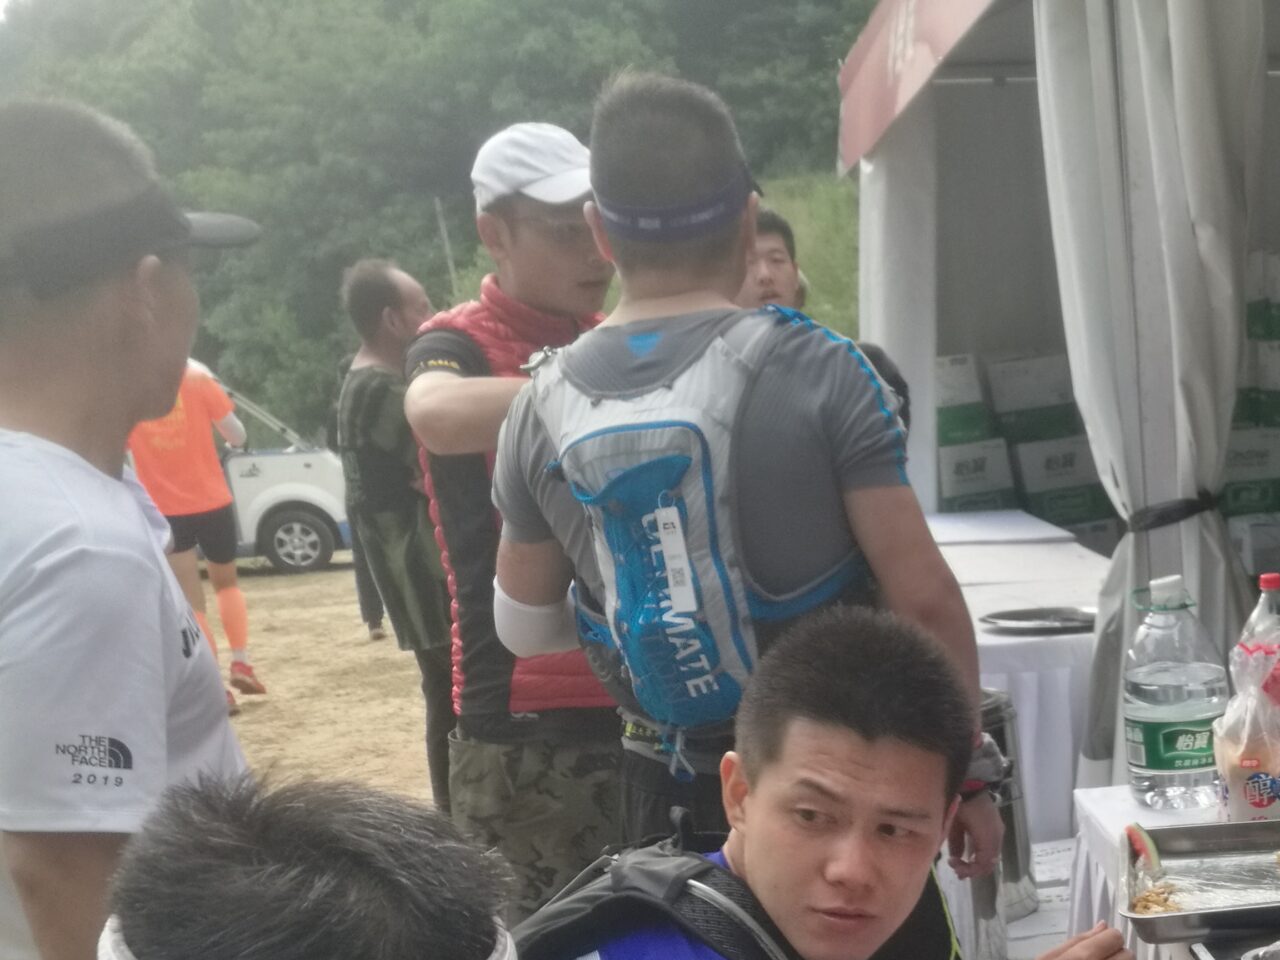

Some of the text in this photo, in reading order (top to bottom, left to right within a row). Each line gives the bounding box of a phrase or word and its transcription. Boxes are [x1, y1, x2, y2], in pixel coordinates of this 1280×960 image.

[79, 734, 107, 746] THE
[55, 744, 108, 756] NORTH
[71, 756, 108, 768] FACE
[71, 773, 124, 787] 2019
